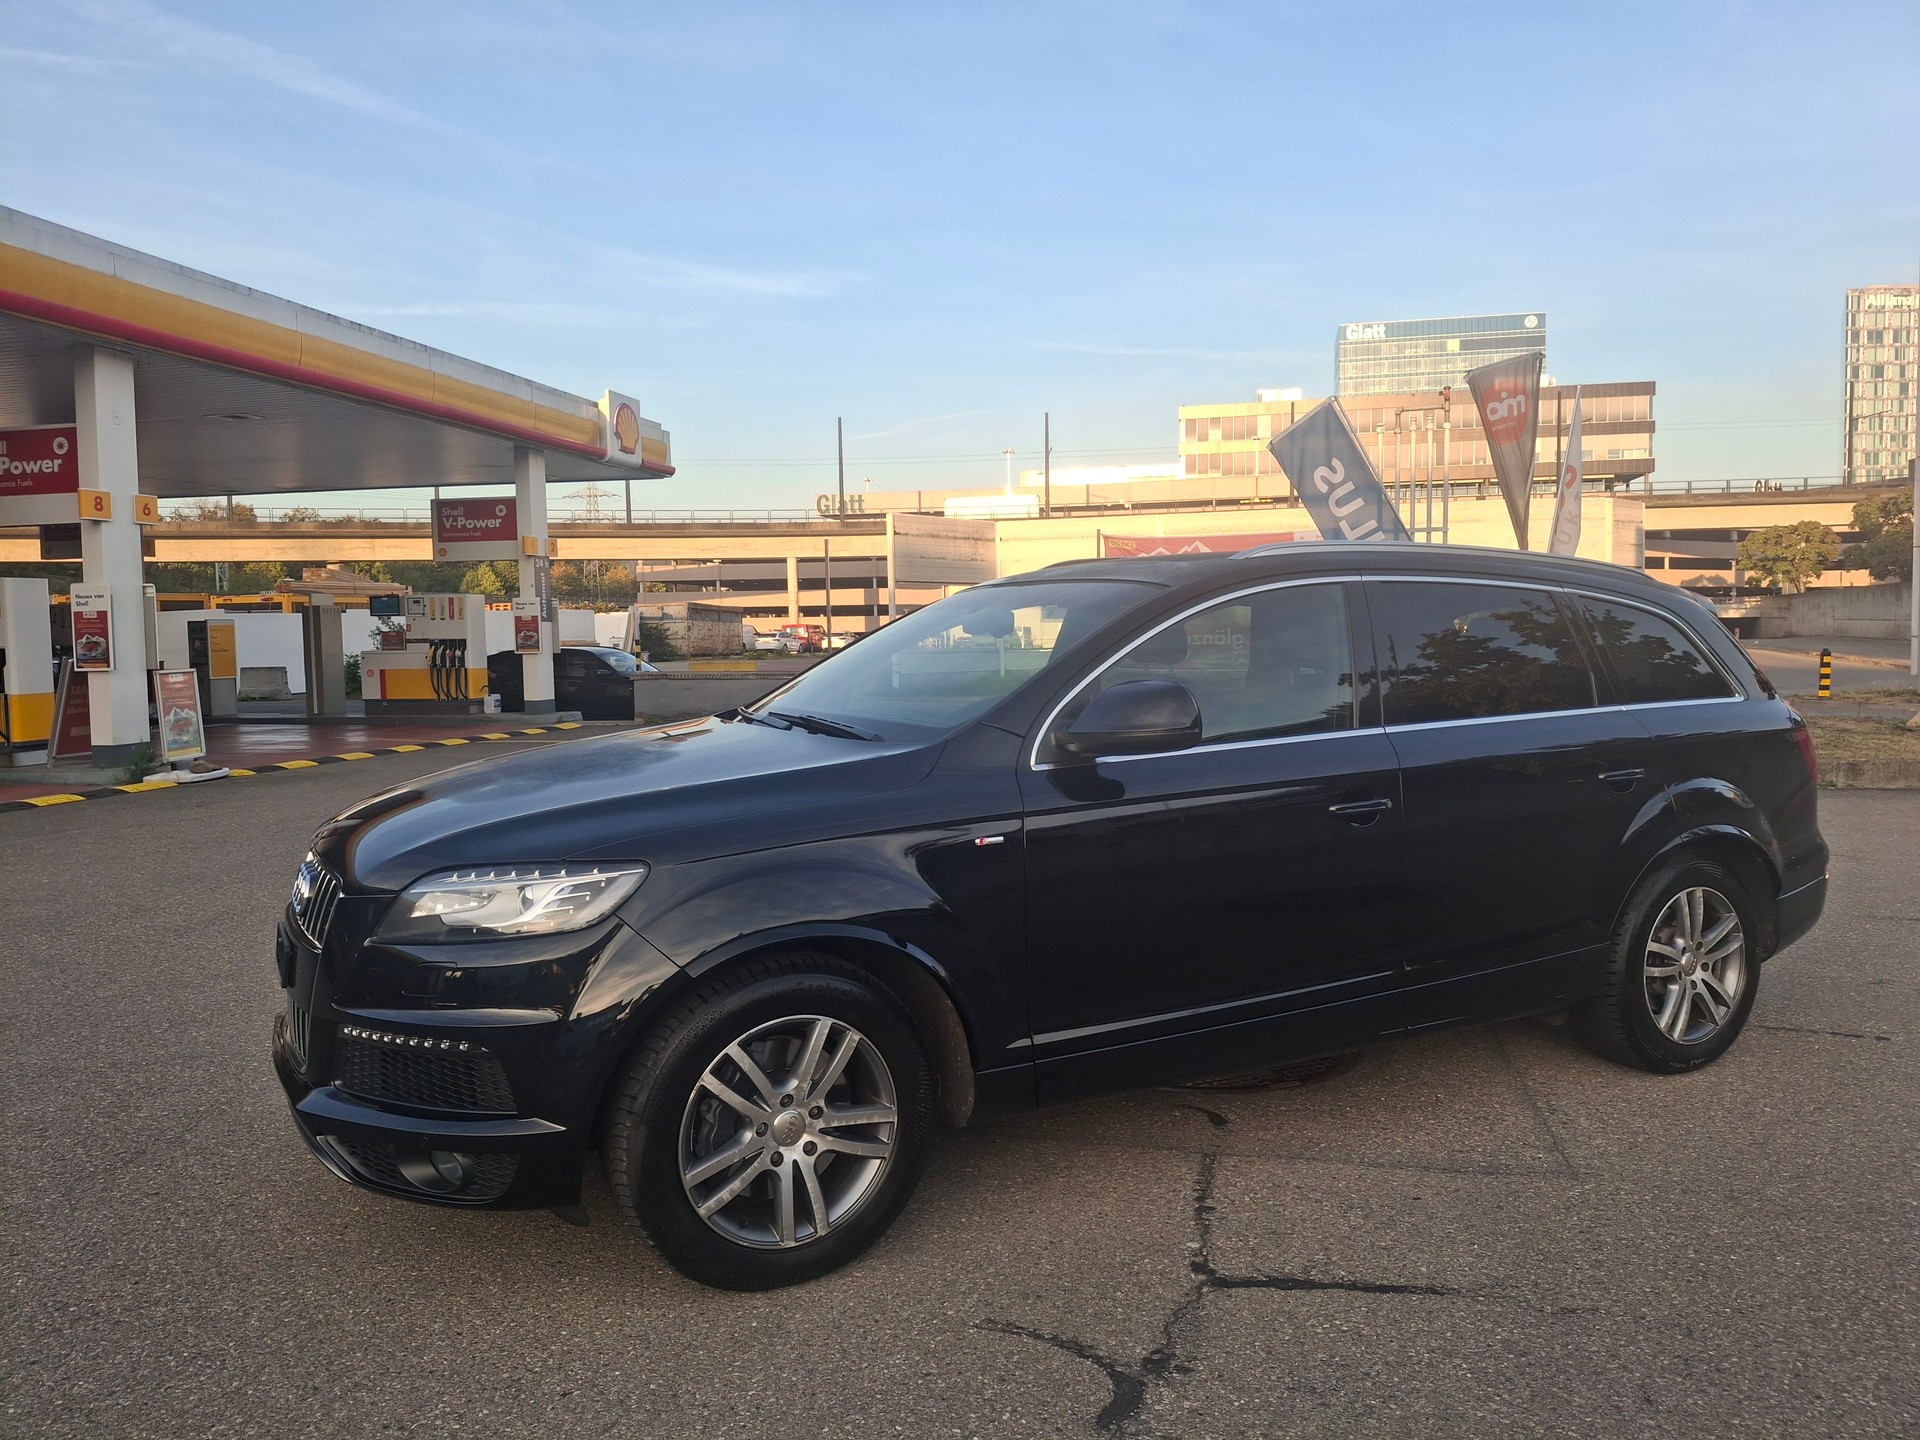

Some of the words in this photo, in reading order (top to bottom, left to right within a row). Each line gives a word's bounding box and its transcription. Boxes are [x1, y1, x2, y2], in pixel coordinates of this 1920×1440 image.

[1346, 323, 1386, 340] Glatt
[94, 495, 104, 512] 8
[142, 502, 152, 516] 6
[816, 494, 865, 514] Glatt
[441, 506, 464, 516] Shell
[442, 517, 502, 529] V-Power
[550, 542, 555, 552] 2
[535, 558, 544, 568] 24
